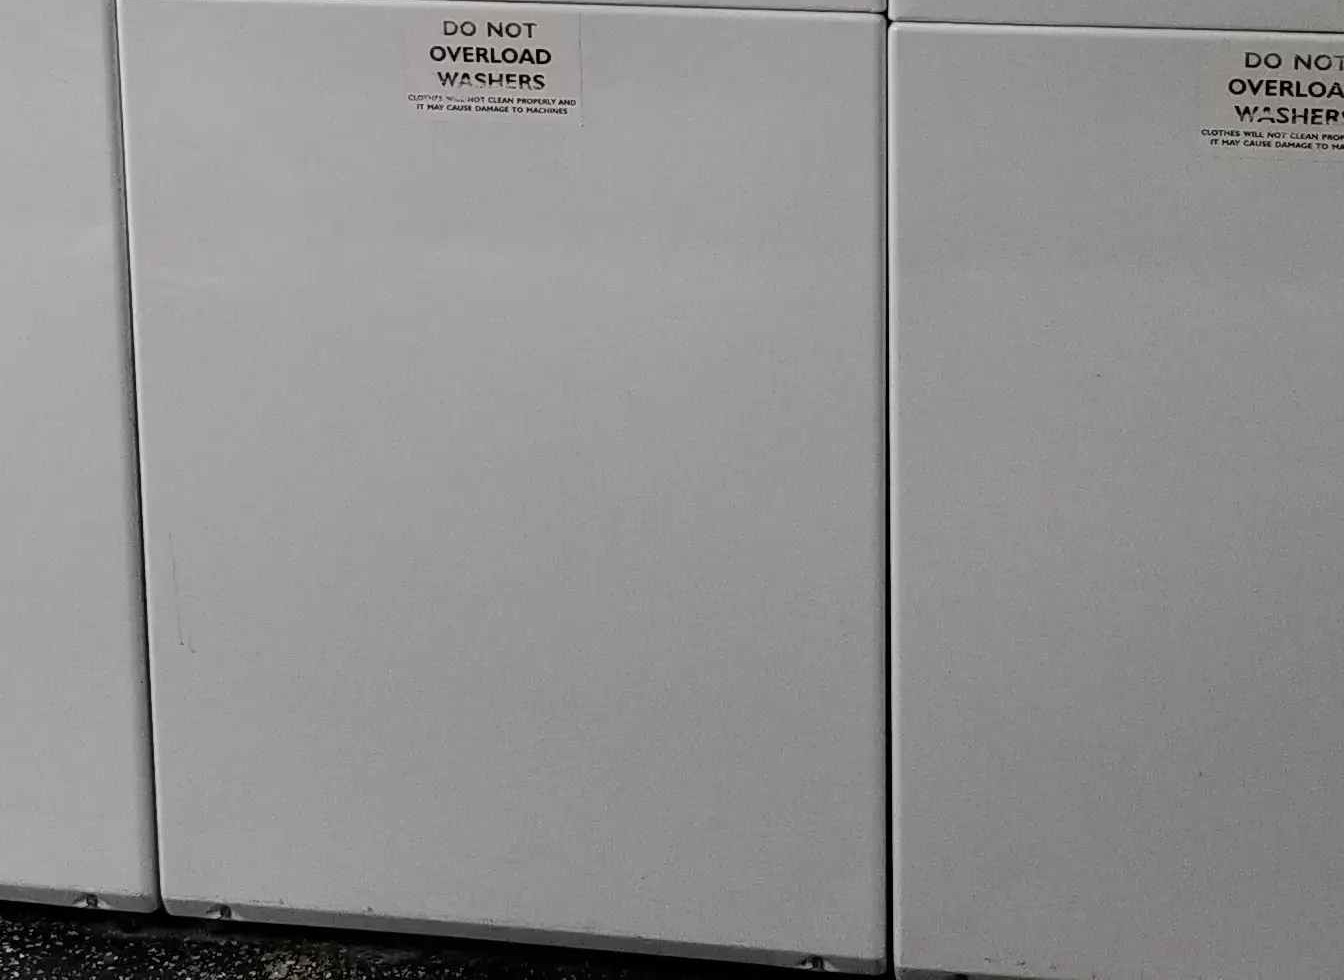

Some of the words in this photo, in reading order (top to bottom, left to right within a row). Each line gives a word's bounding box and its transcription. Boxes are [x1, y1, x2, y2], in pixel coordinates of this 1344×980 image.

[443, 20, 477, 36] DO
[487, 22, 537, 38] NOT
[429, 46, 552, 65] OVERLOAD
[1245, 51, 1282, 69] DO
[437, 71, 546, 90] WASHERS
[475, 105, 508, 113] DAMAGE
[526, 107, 568, 115] MACHINES
[1201, 129, 1240, 137] CLOTHES
[1243, 130, 1264, 138] WILL
[1267, 131, 1286, 139] NOT
[1289, 132, 1319, 140] CLEAN
[1243, 139, 1272, 148] CAUSE
[1275, 141, 1312, 149] DAMAGE
[1316, 142, 1329, 150] TO
